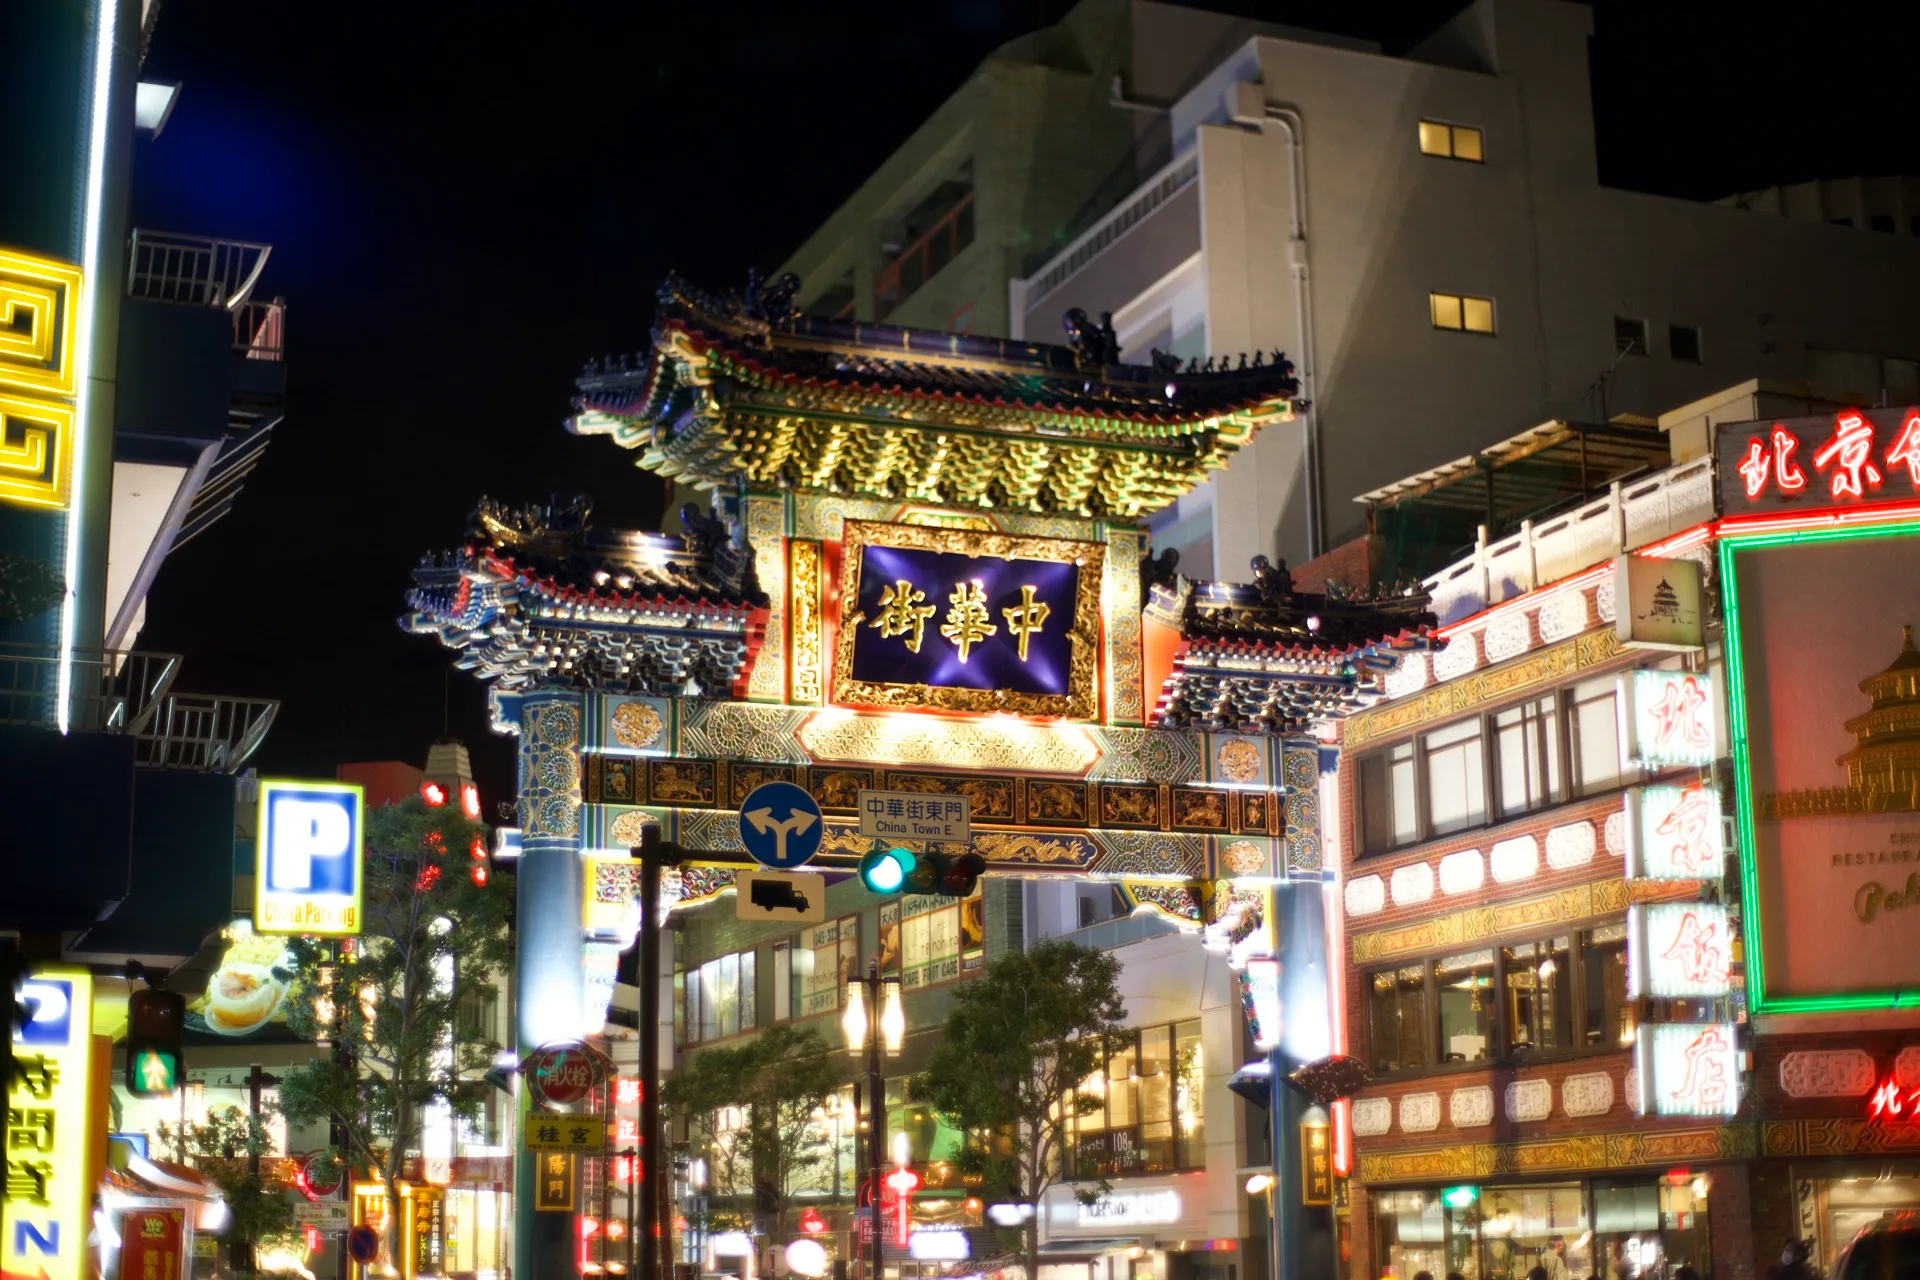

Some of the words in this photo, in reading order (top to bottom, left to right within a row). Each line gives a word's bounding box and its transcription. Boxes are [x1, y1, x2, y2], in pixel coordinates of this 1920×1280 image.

[867, 796, 963, 822] 中華街東門
[876, 820, 907, 833] China
[912, 822, 940, 835] Town
[944, 825, 955, 836] E.
[1890, 832, 1920, 846] CHI
[272, 799, 350, 888] P
[1649, 676, 1731, 1105] 北京飯店
[941, 960, 958, 978] CARE
[543, 1065, 589, 1087] 消火栓
[1871, 1079, 1920, 1114] 北
[536, 1124, 592, 1143] 桂宮
[1311, 1131, 1327, 1196] 朝陽門
